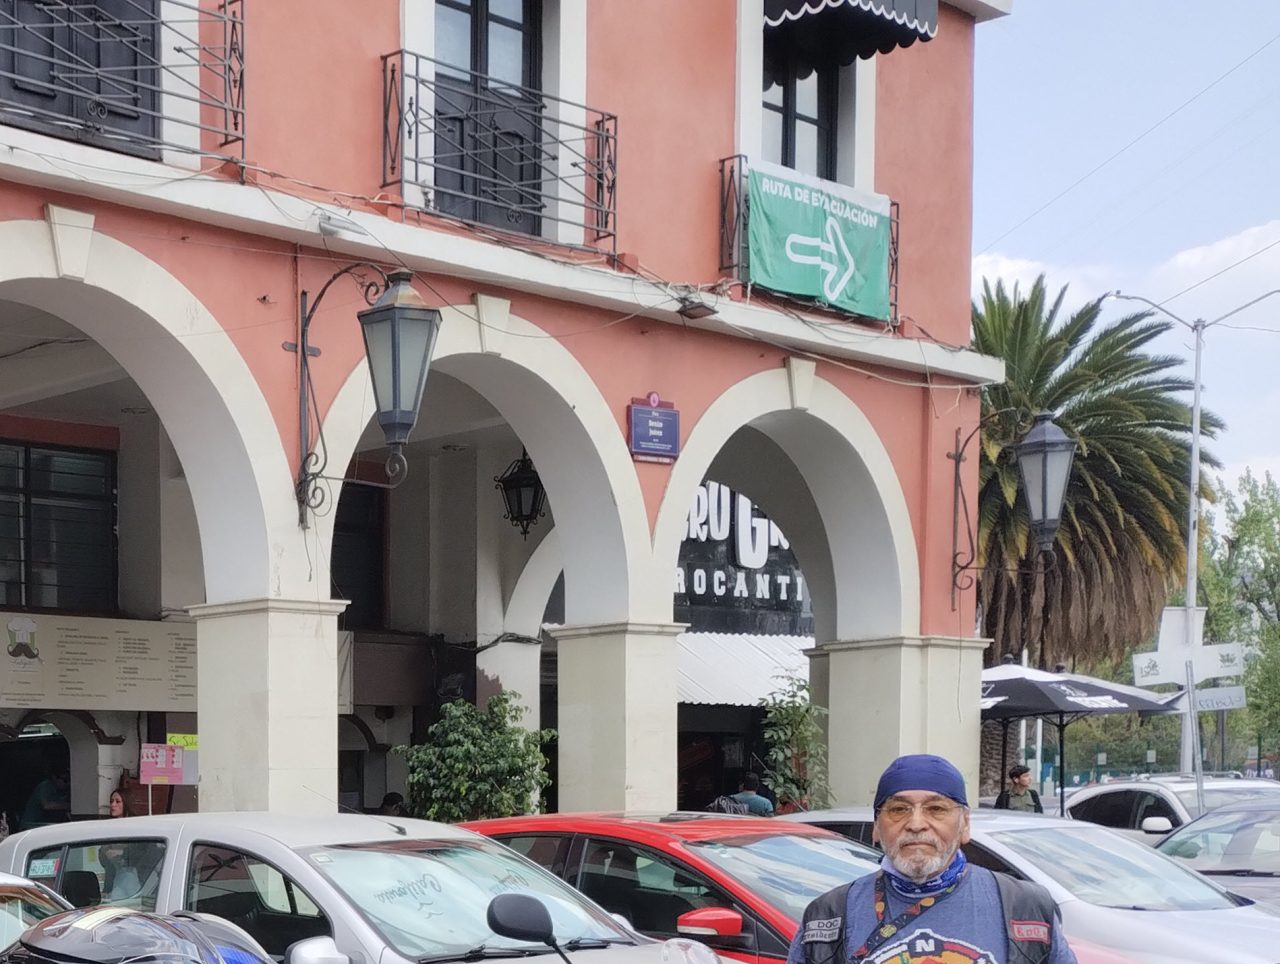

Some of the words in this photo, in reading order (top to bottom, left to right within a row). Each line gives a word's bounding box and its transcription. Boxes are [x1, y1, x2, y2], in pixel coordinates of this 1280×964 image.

[762, 177, 792, 200] RUTA
[794, 187, 810, 204] DE
[811, 191, 878, 228] EVACUACIÓN
[915, 939, 936, 953] N
